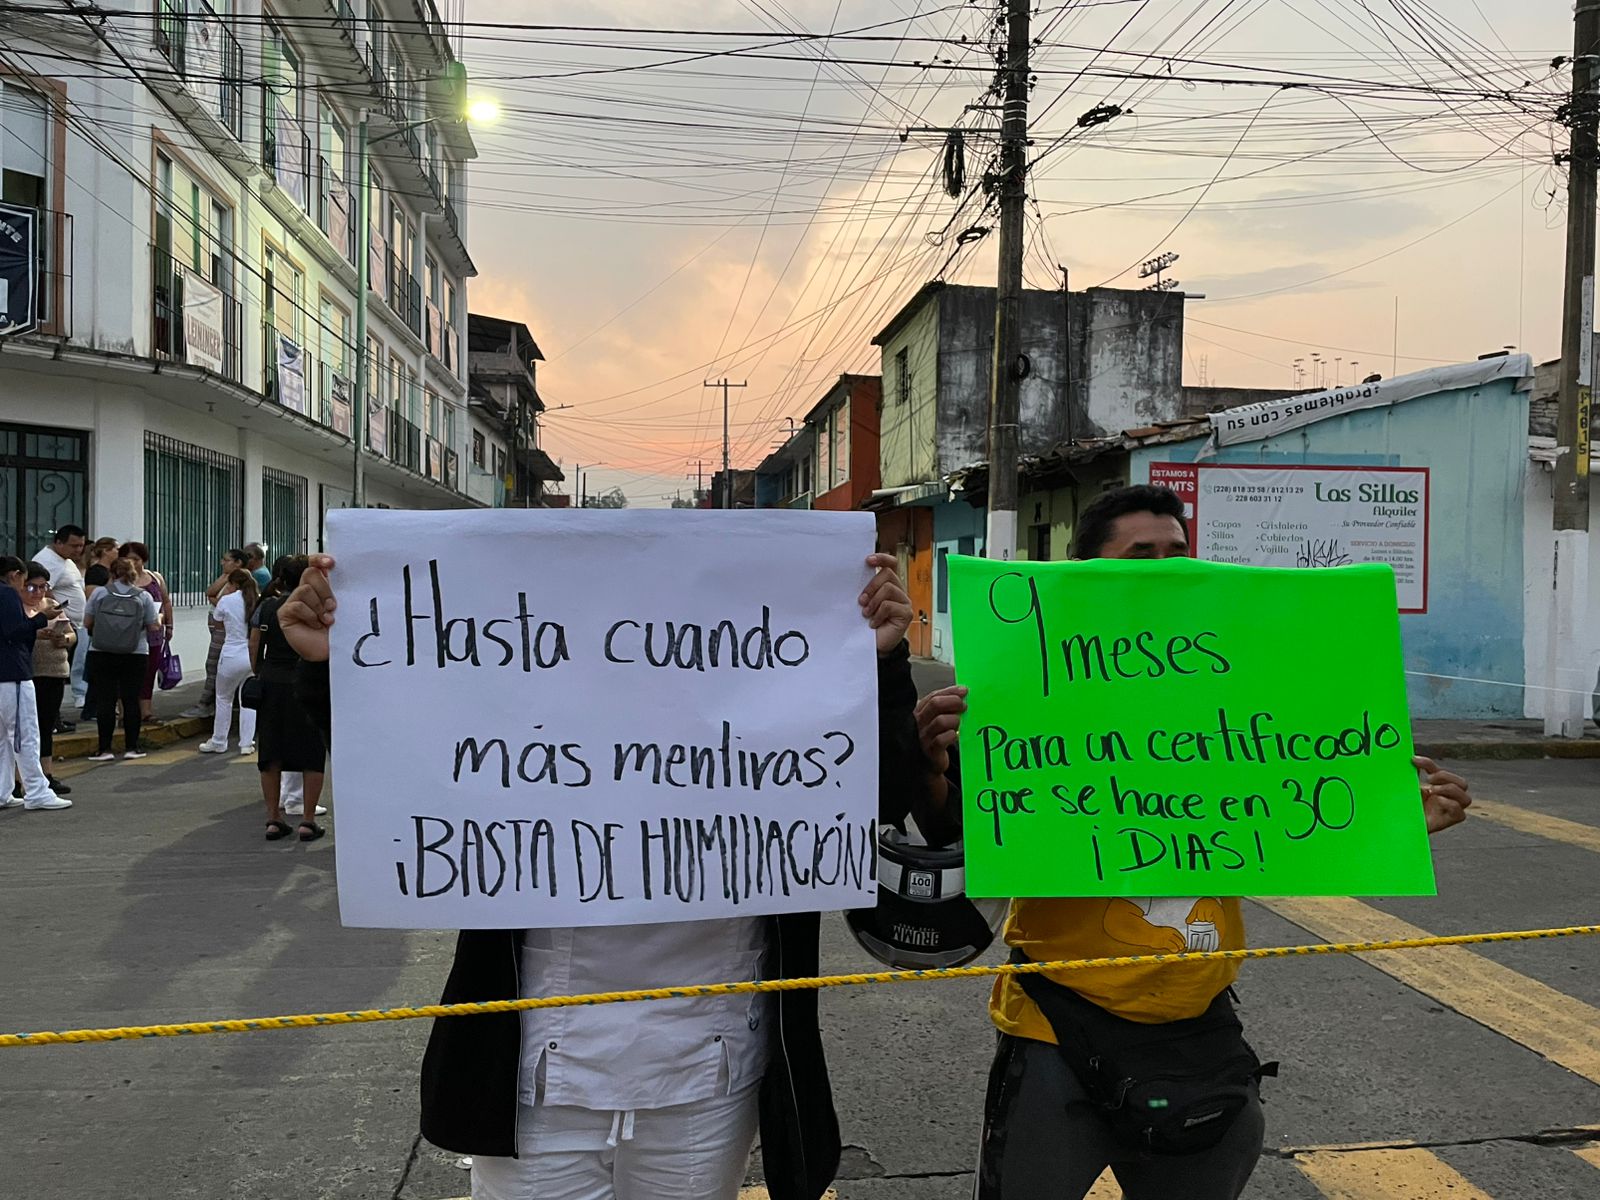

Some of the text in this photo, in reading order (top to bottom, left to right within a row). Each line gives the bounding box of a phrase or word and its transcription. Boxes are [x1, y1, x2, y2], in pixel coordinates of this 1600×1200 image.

[1227, 418, 1245, 430] su
[1250, 413, 1279, 426] con
[1152, 470, 1188, 478] ESTAMOS
[1168, 481, 1195, 492] MTS
[1314, 482, 1419, 503] Las Sillas
[1373, 506, 1418, 518] Alquiler
[1211, 520, 1242, 529] Carpas
[1211, 531, 1235, 540] Sillas
[1260, 533, 1304, 542] Cubiertos
[1211, 543, 1238, 551] Mesas
[1260, 545, 1289, 555] Vajilla
[352, 558, 810, 672] ¿Hasta cuando
[988, 572, 1232, 697] 9 meses
[976, 707, 1401, 782] Para un certificado
[452, 720, 856, 791] más mentiras?
[1052, 783, 1100, 816] se
[1109, 776, 1207, 822] hace
[1219, 793, 1271, 822] en
[1280, 776, 1355, 841] 30
[571, 818, 625, 903] DE
[911, 877, 931, 887] DOT
